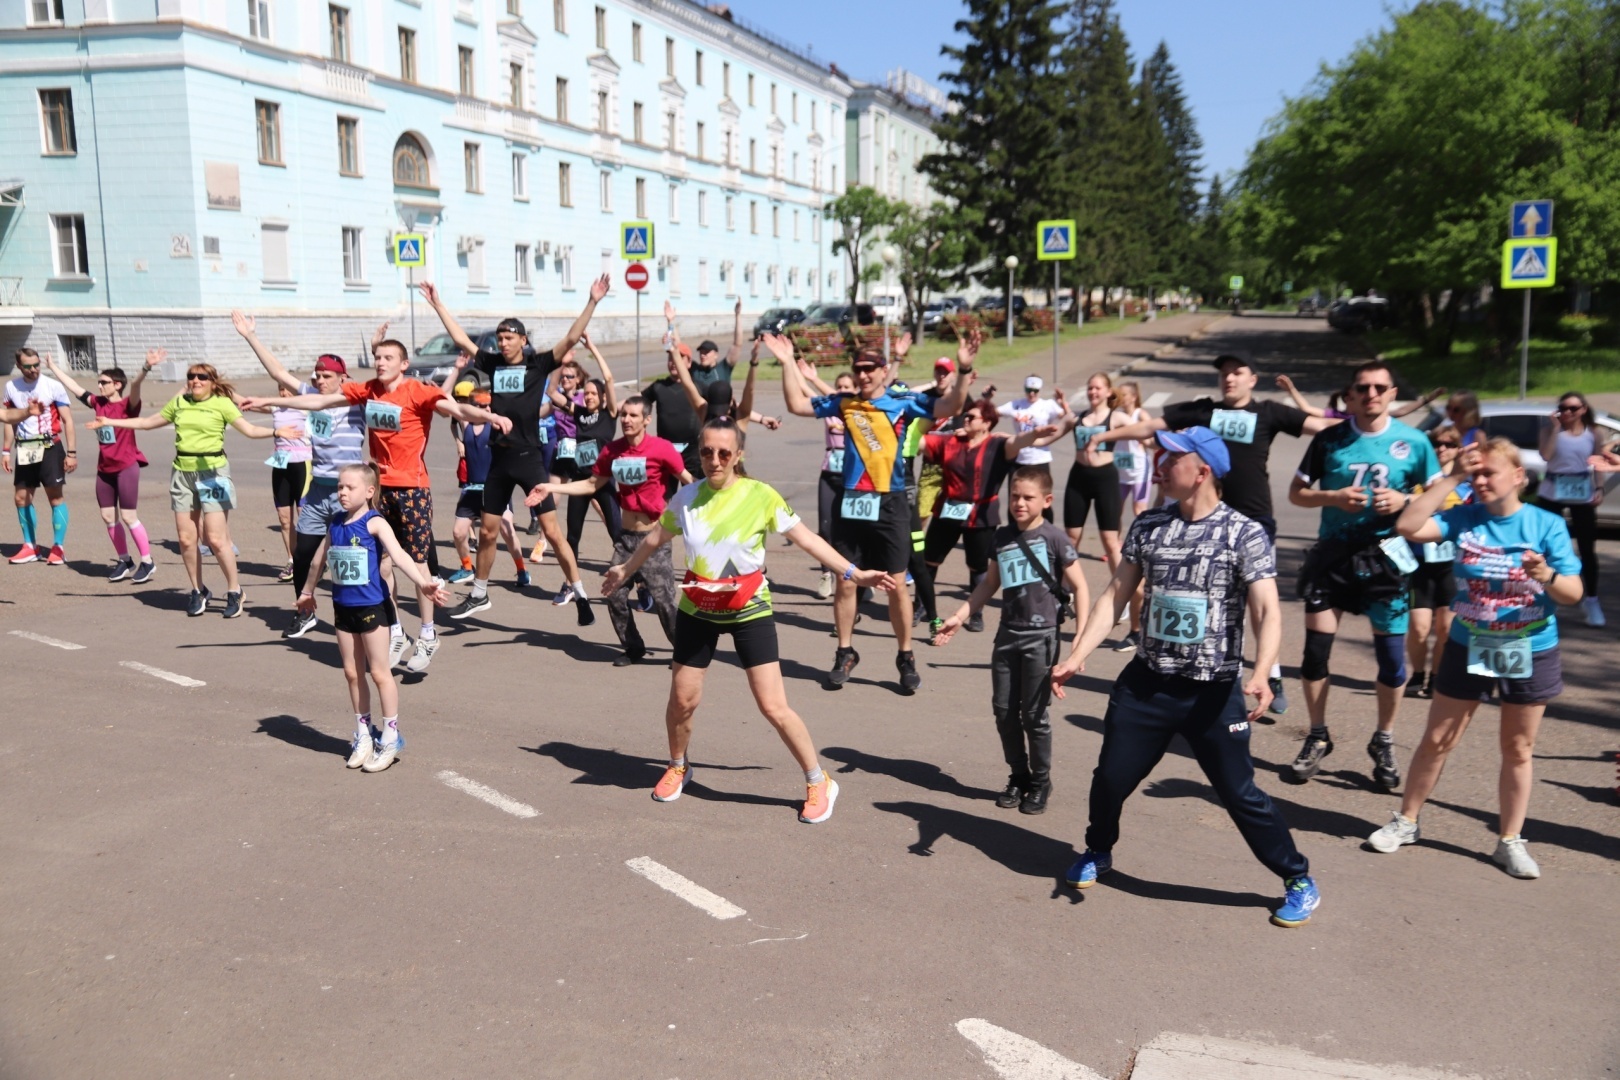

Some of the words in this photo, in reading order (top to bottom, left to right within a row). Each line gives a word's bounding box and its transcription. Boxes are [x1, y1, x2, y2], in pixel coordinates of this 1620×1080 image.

[172, 236, 190, 253] 24
[499, 376, 520, 390] 146
[371, 412, 397, 429] 148
[1217, 419, 1247, 438] 159
[580, 450, 596, 464] 104
[617, 467, 643, 483] 144
[1348, 462, 1389, 491] 73
[205, 487, 225, 500] 167
[850, 498, 873, 517] 130
[333, 560, 361, 581] 125
[1152, 607, 1199, 639] 123
[1478, 649, 1525, 674] 102
